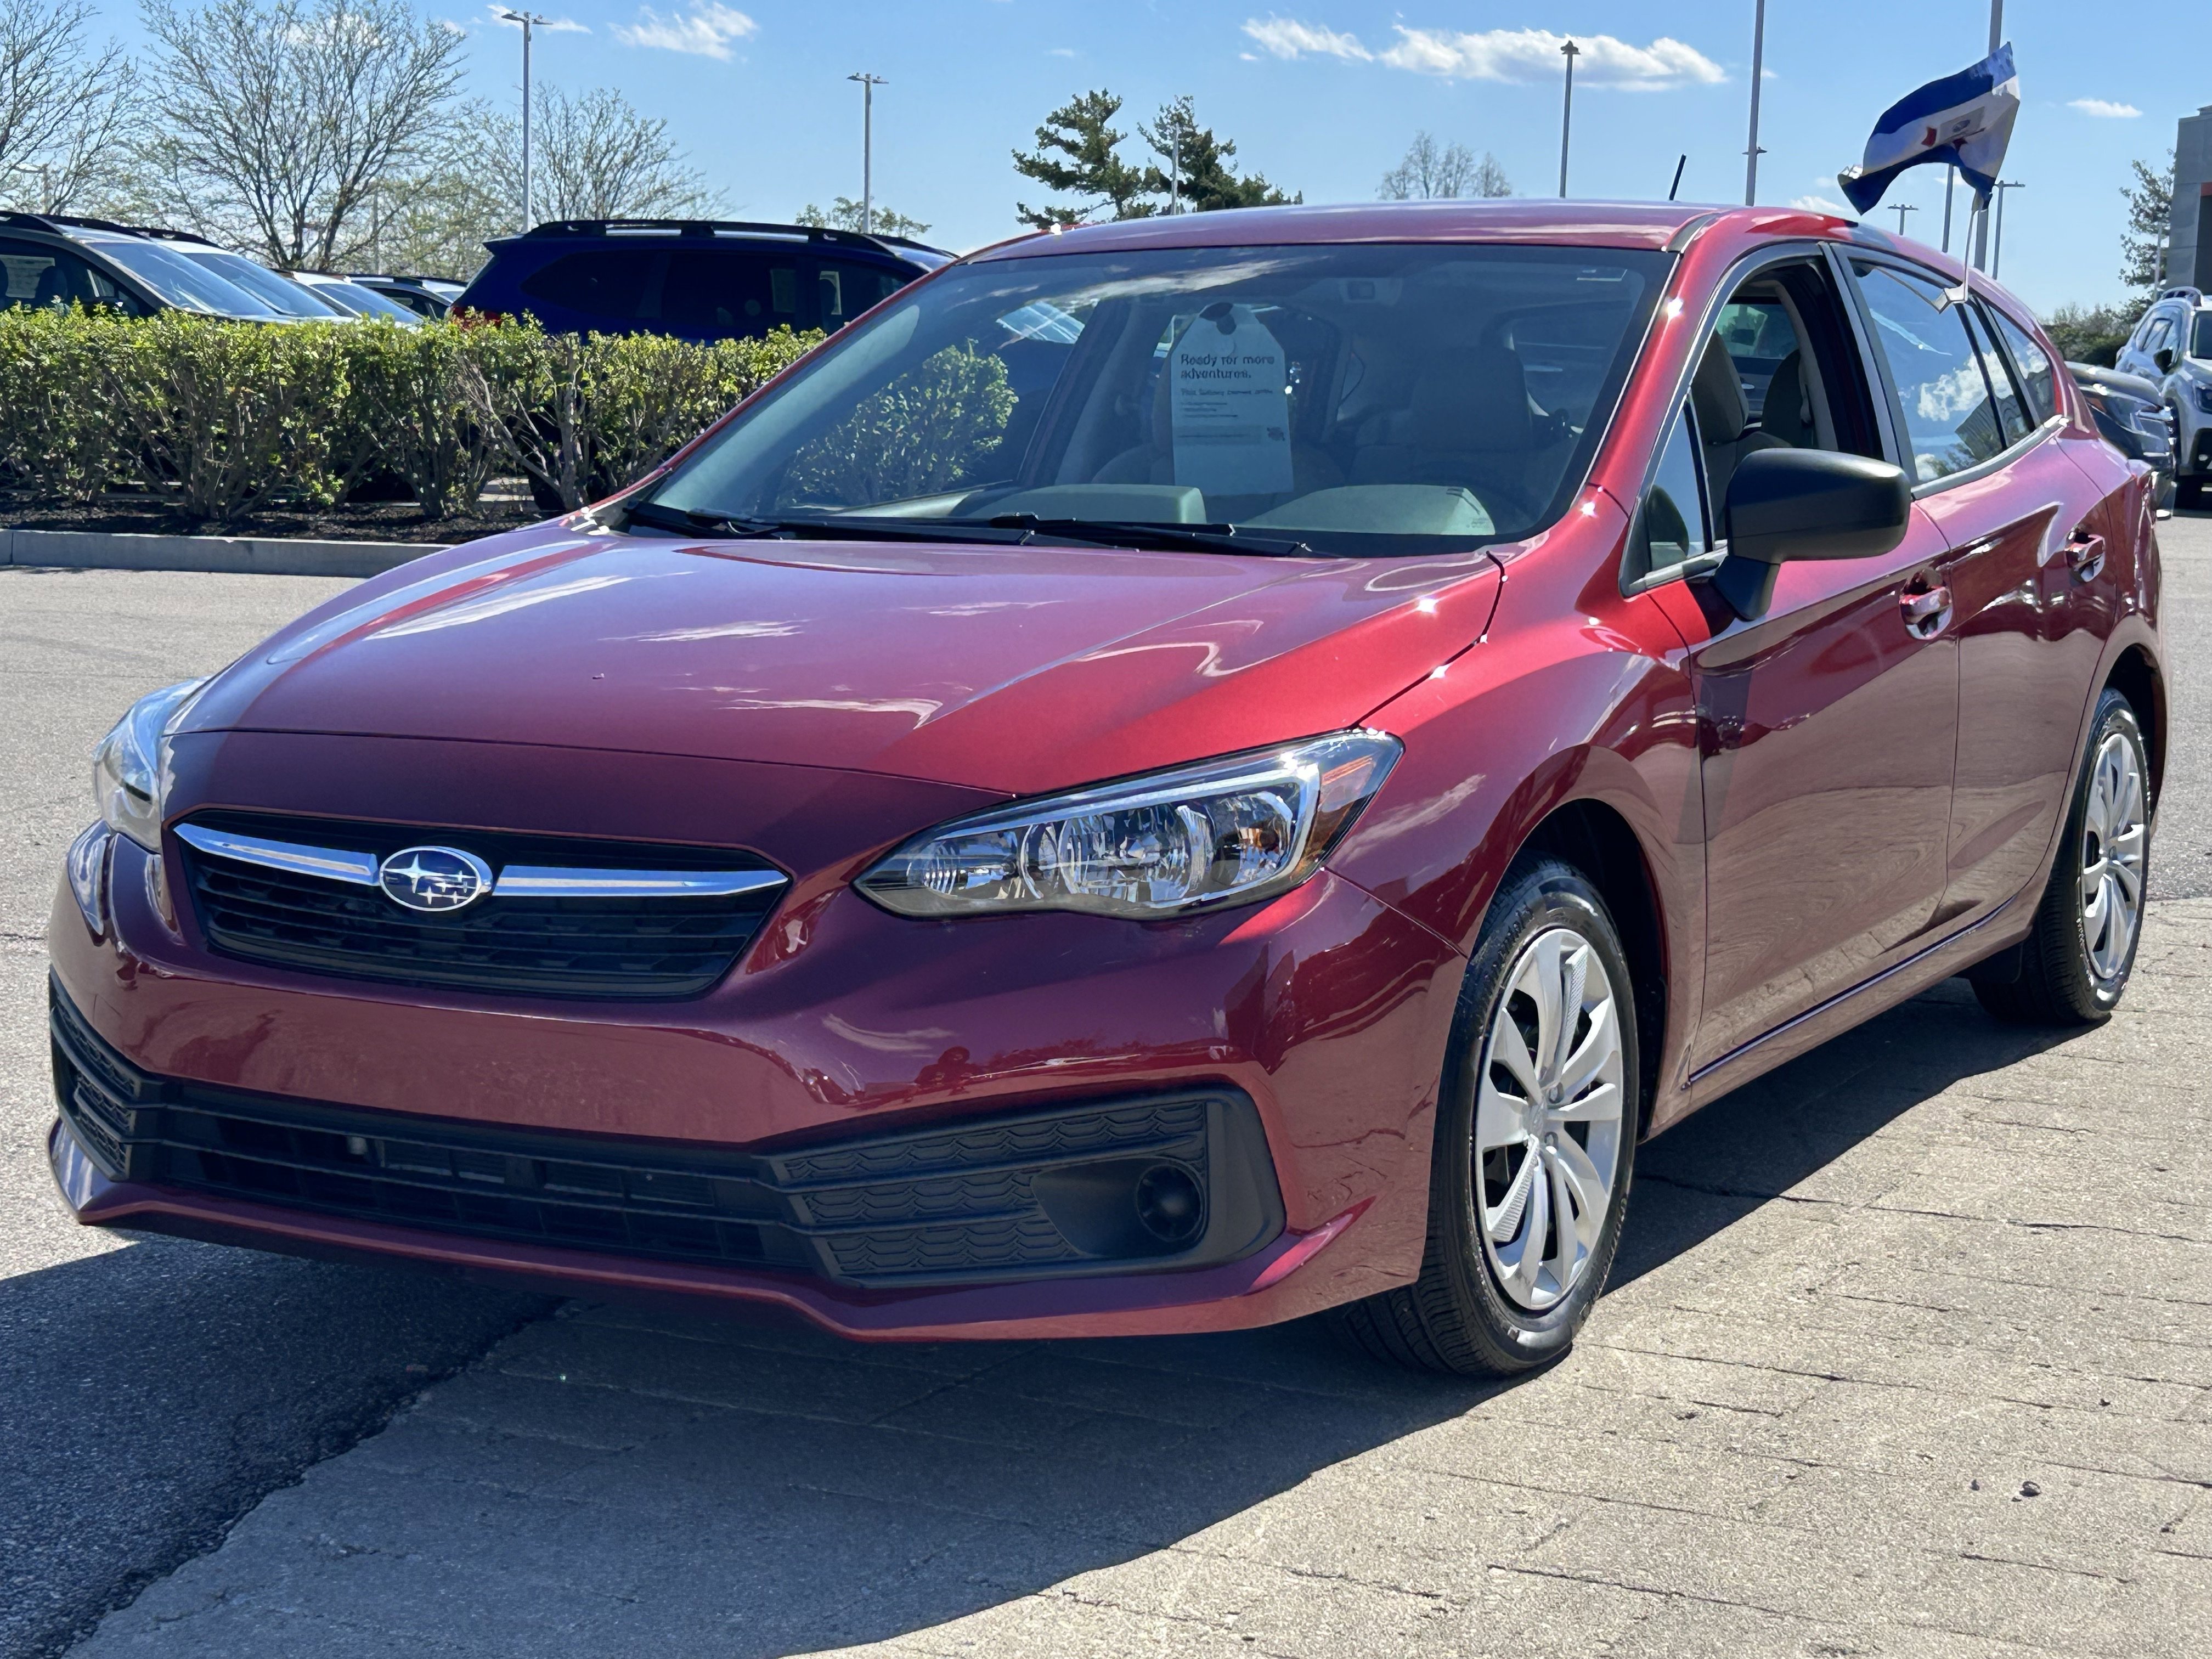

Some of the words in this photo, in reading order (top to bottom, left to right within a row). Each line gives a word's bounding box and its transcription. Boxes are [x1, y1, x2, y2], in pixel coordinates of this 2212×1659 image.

[1181, 354, 1217, 367] Ready
[1221, 355, 1238, 365] for
[1243, 356, 1275, 365] more
